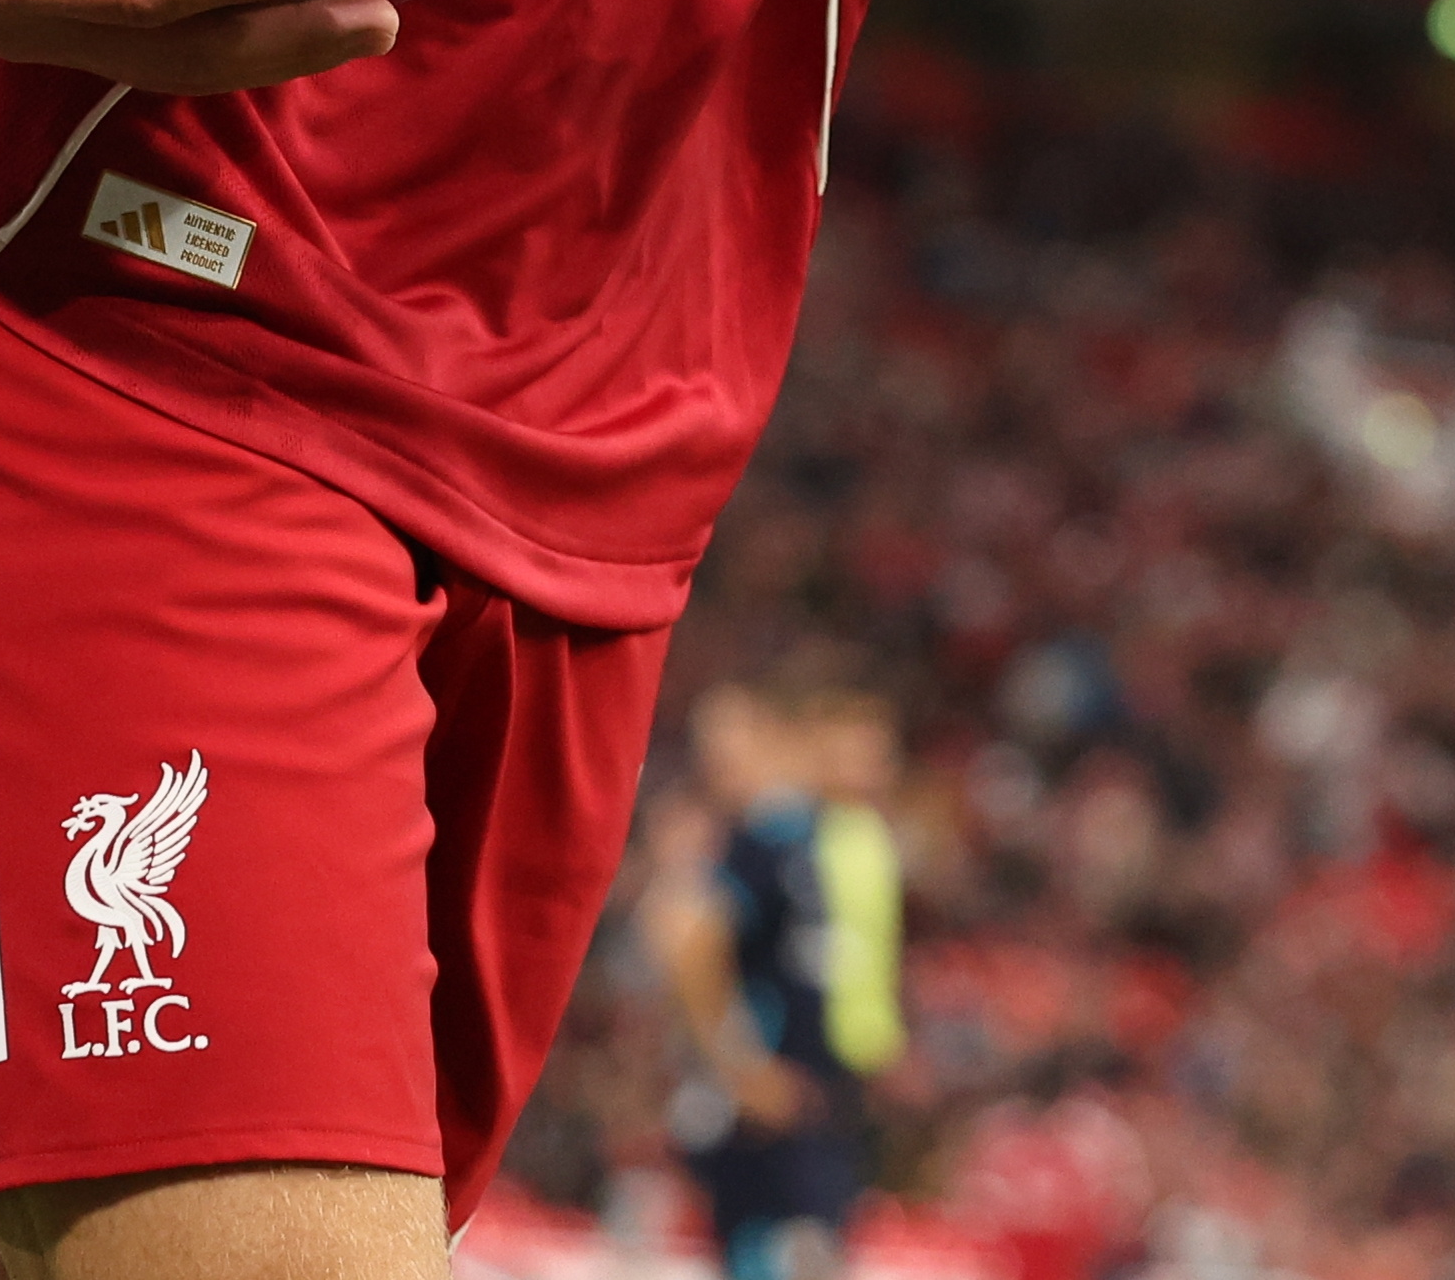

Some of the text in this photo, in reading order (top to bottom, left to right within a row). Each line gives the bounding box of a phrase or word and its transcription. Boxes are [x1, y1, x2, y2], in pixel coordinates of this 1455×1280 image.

[183, 212, 236, 241] AUTHENTIC
[185, 231, 230, 258] LICENSED
[180, 249, 225, 274] PRODUCT
[57, 994, 210, 1059] L.F.C.
